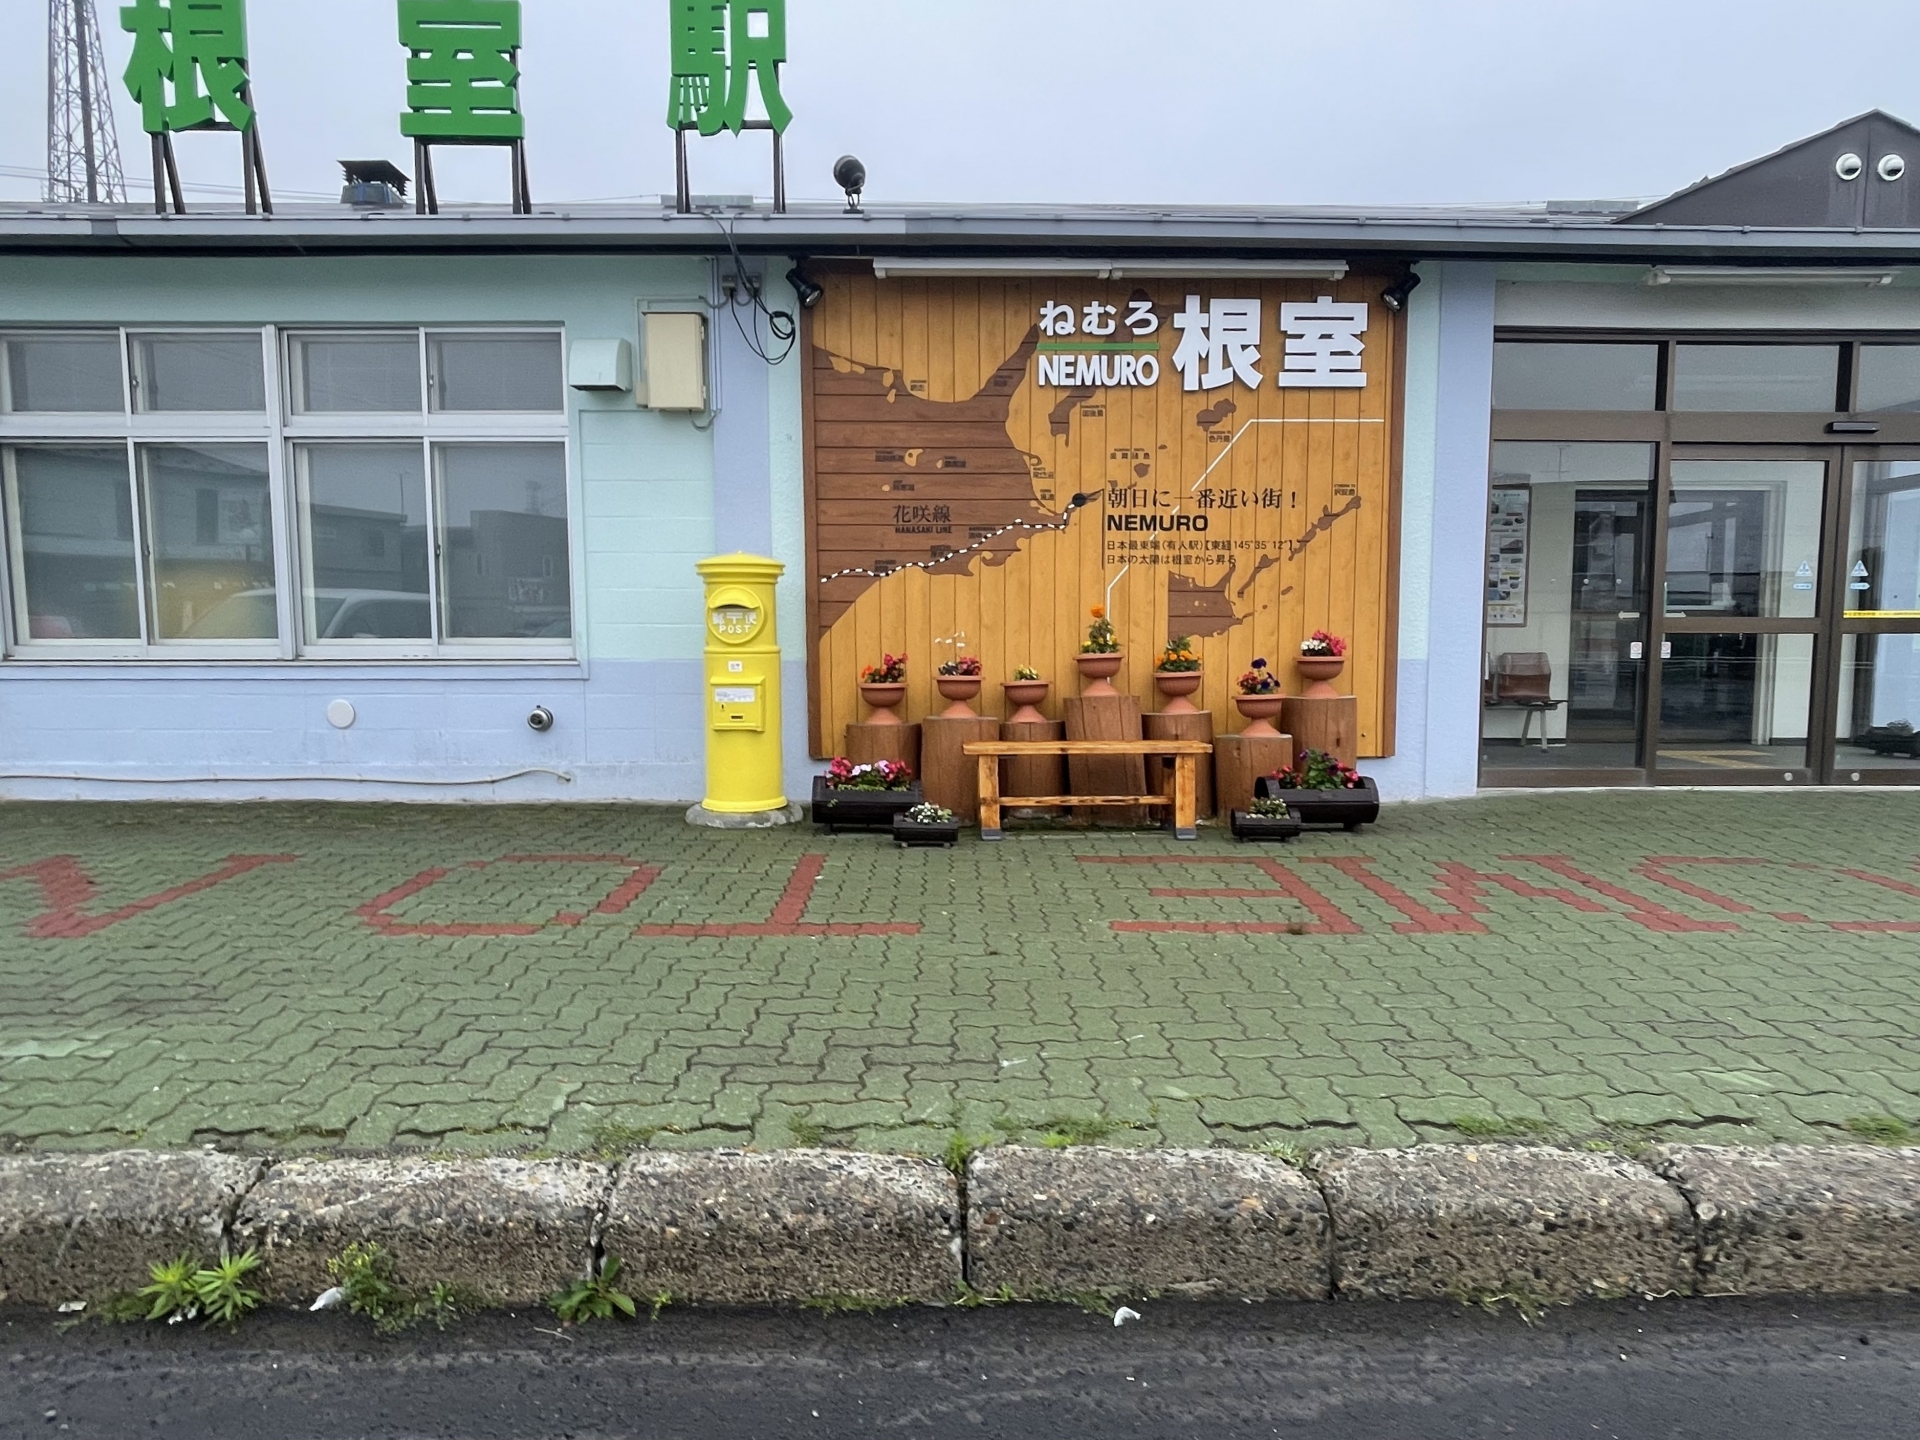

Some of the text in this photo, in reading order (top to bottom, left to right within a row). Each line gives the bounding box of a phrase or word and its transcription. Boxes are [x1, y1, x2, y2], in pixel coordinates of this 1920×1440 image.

[1039, 300, 1159, 336] ねむろ
[1172, 294, 1368, 391] 根室
[1038, 354, 1160, 387] NEMURO
[893, 504, 952, 524] 花咲線
[1106, 514, 1209, 532] NEMURO
[895, 526, 953, 535] HANASAKI LINE
[718, 624, 751, 634] POST
